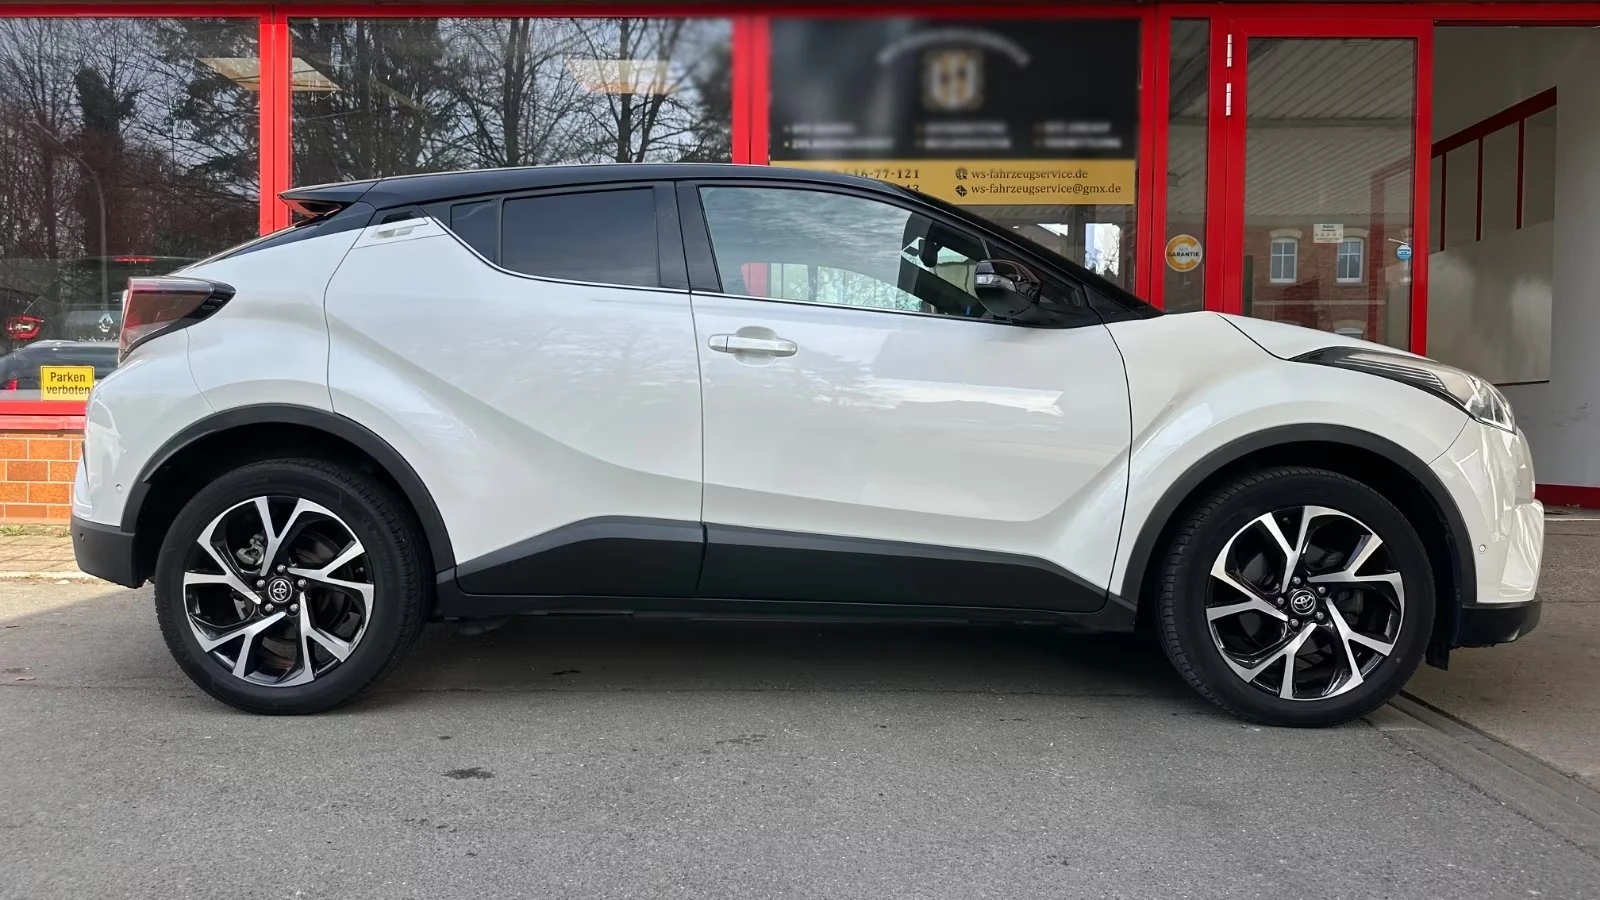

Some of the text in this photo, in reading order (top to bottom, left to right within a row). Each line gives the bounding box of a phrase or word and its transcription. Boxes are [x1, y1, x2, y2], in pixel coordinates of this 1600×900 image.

[971, 168, 1088, 180] ws-fahrzeugservice.de
[971, 183, 1121, 195] ws-fahrzeugservice@gmx.de
[50, 371, 86, 382] Parken
[46, 385, 91, 395] verboten
